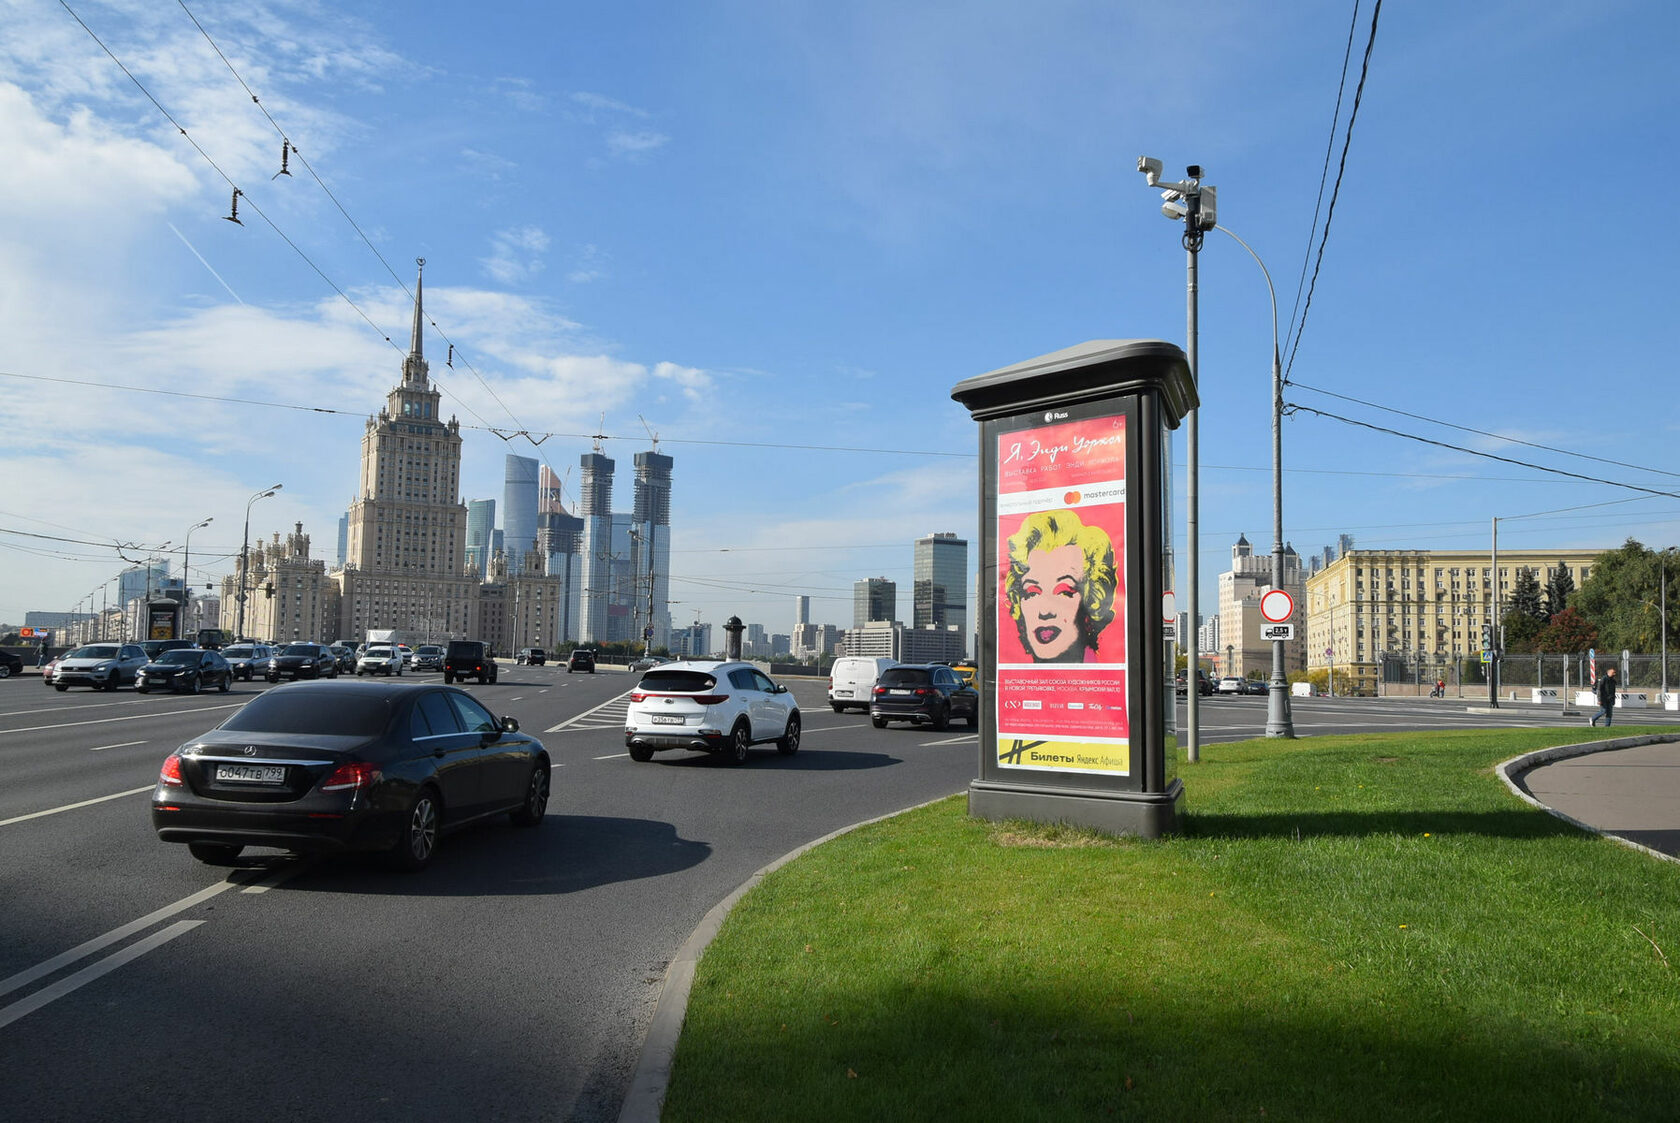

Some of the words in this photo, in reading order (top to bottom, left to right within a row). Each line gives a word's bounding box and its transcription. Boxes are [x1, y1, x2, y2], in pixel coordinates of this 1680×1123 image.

[1040, 464, 1062, 472] РАБОТ
[1084, 488, 1125, 500] mastercard
[1030, 752, 1075, 763] Билеты
[1076, 754, 1099, 766] Яндекс
